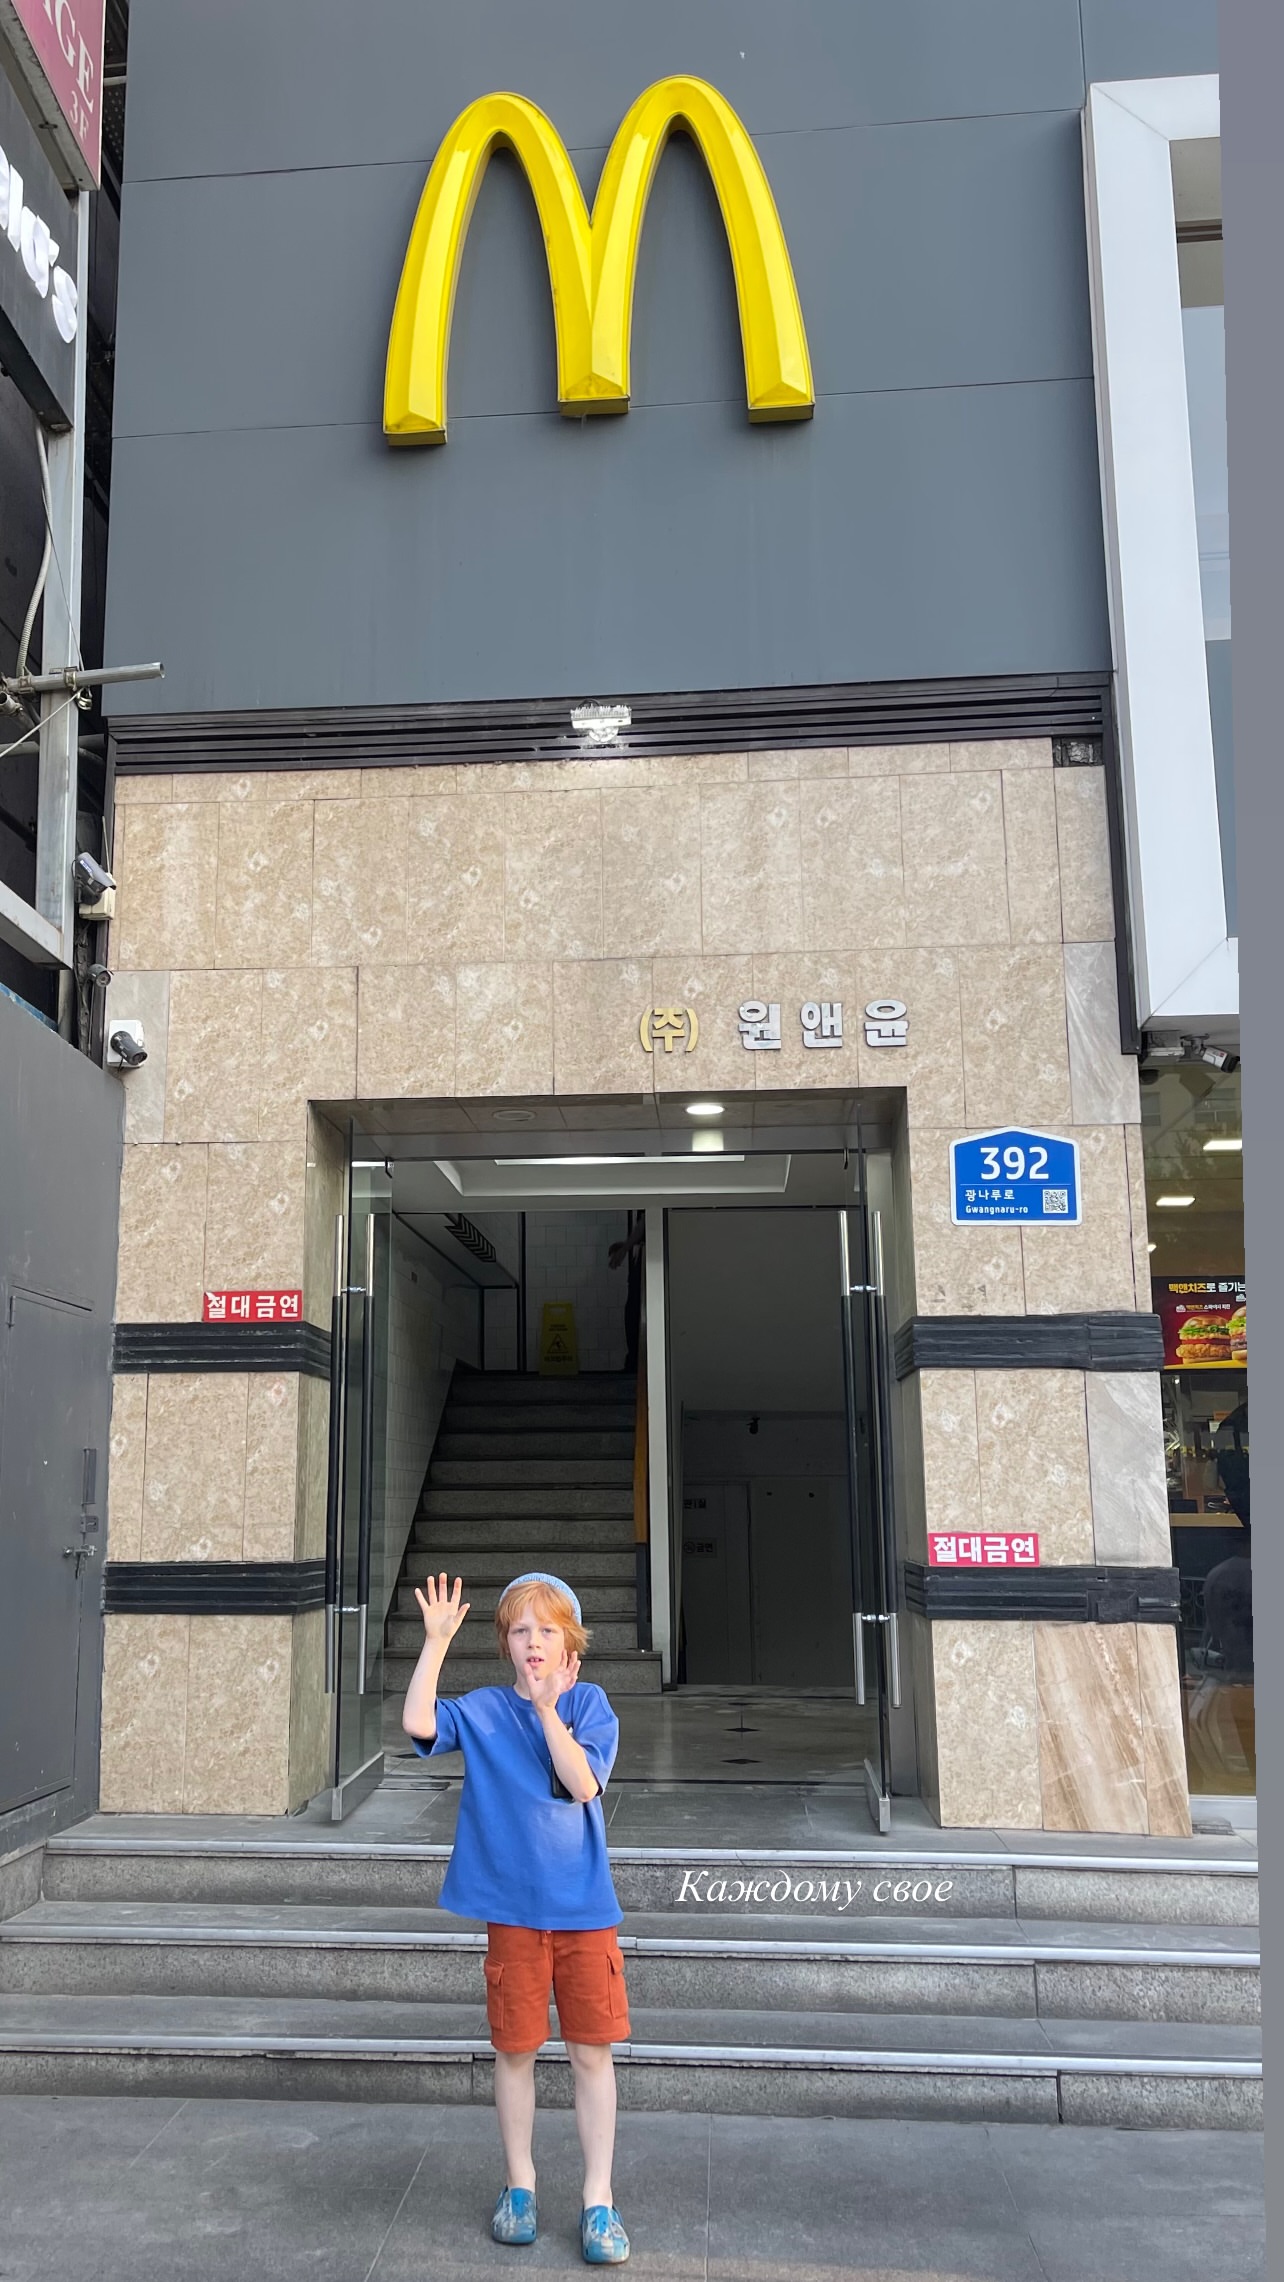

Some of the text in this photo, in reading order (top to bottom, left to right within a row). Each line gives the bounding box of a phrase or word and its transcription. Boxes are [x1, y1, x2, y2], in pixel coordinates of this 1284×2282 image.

[70, 90, 89, 142] 3F
[383, 74, 815, 446] M
[640, 1007, 699, 1053] (주)
[980, 1146, 1049, 1180] 392
[965, 1189, 1015, 1202] 광나루로
[965, 1205, 1028, 1215] Gwangnaru-ro
[207, 1294, 299, 1319] 절대금연
[933, 1536, 1036, 1563] 절대금연
